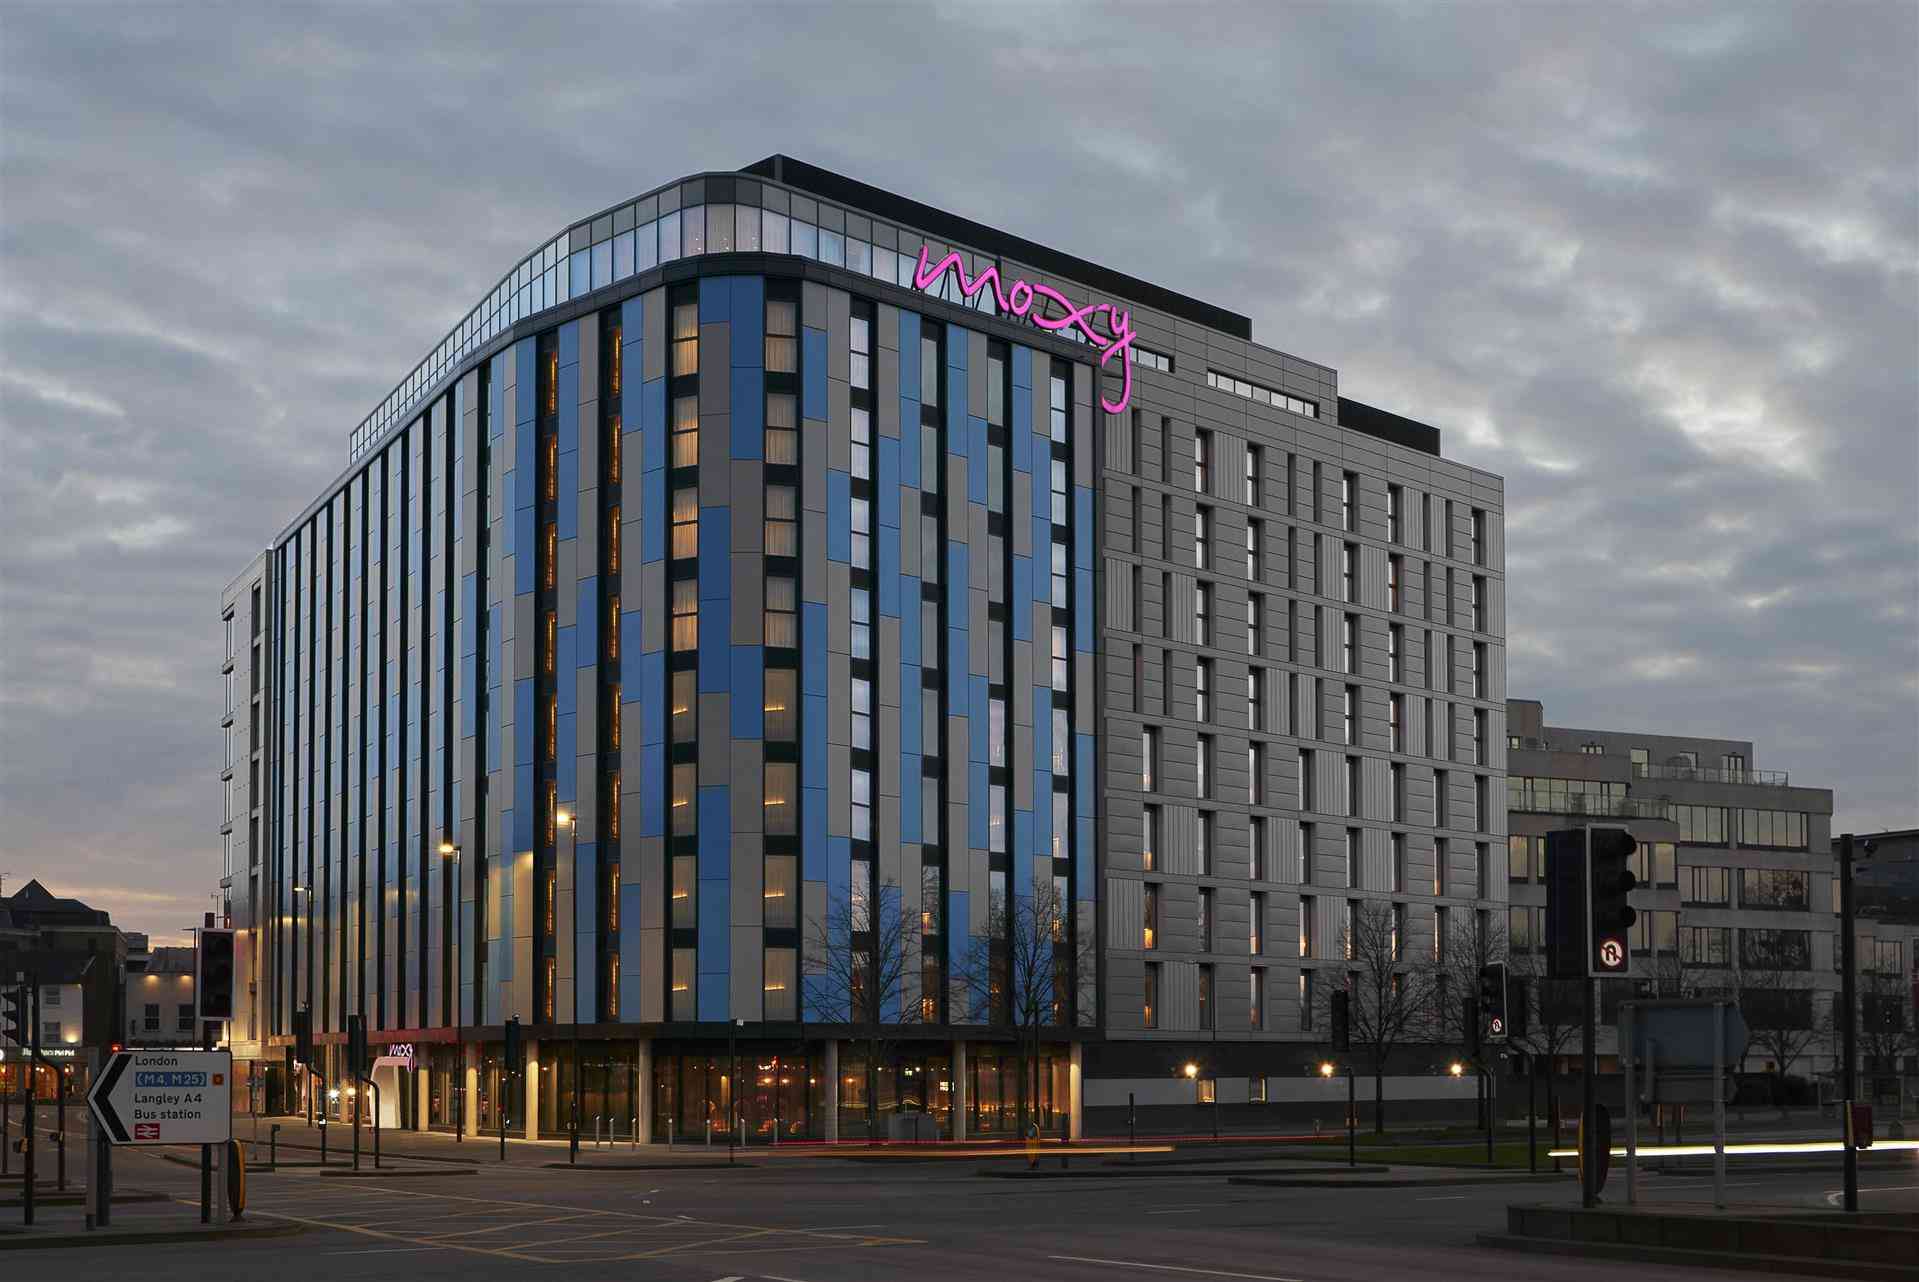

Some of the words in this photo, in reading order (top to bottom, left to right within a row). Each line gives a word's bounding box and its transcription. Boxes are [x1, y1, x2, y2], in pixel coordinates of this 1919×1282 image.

[914, 244, 1137, 415] moxy
[135, 1056, 178, 1066] London
[172, 1072, 206, 1086] M25)
[134, 1093, 180, 1105] Langley
[184, 1093, 203, 1103] A4
[134, 1109, 157, 1119] Bus
[160, 1109, 201, 1119] station
